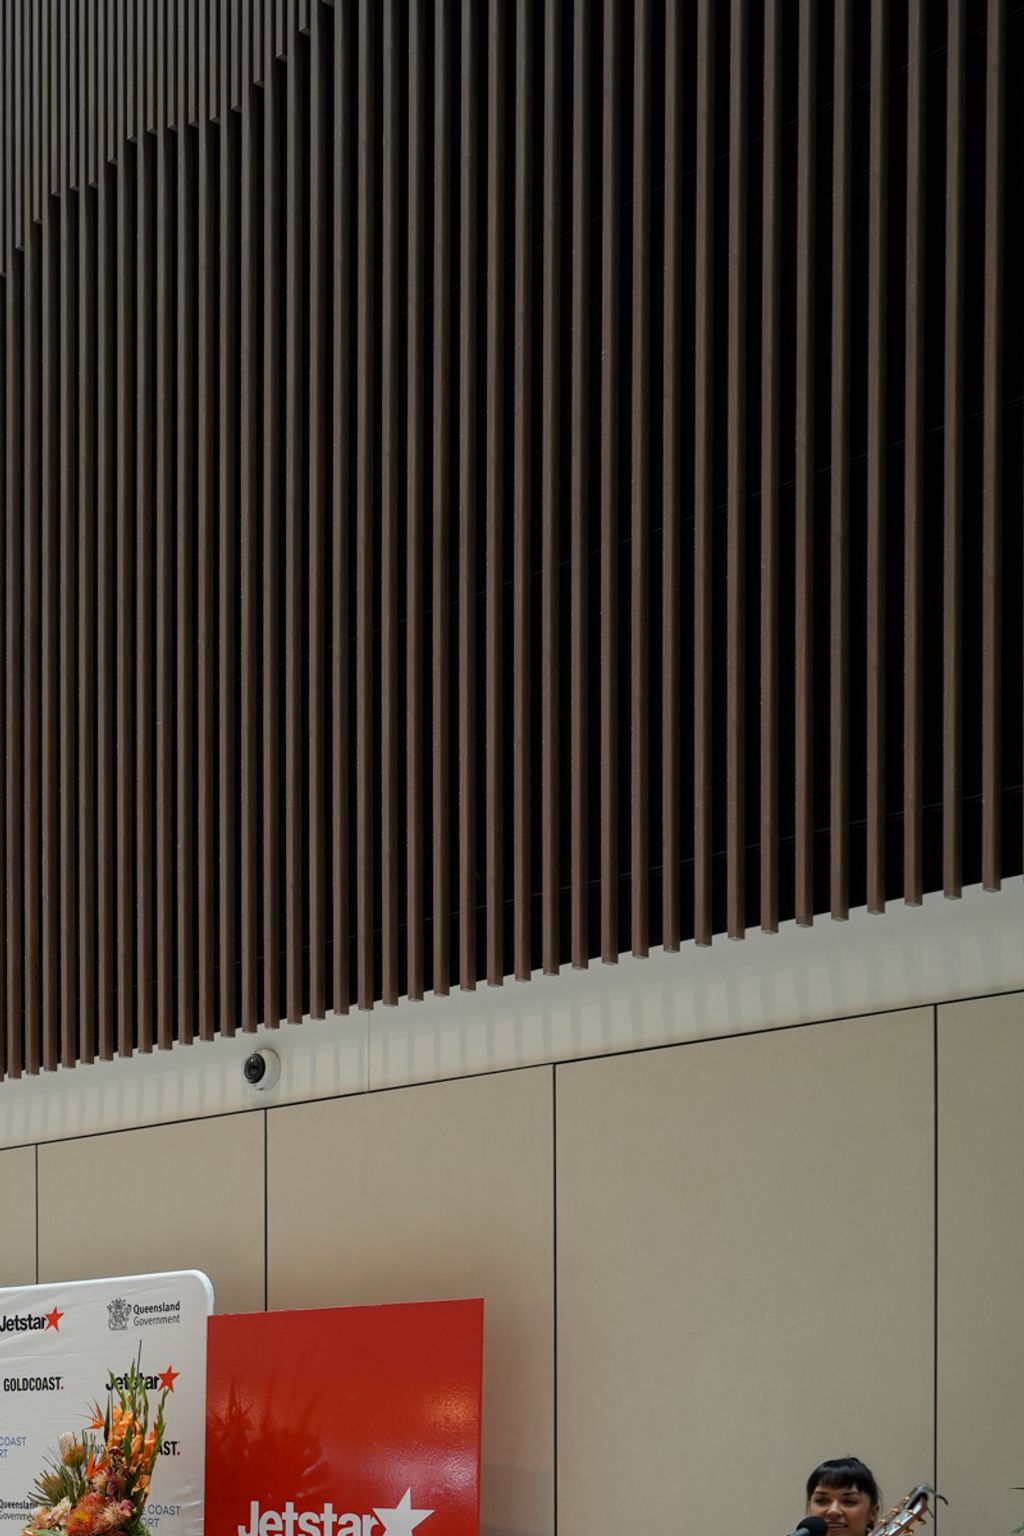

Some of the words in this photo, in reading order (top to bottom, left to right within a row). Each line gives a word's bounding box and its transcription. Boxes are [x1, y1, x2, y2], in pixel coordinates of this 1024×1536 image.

[133, 1301, 180, 1314] Queensland
[133, 1314, 180, 1326] Government
[148, 1504, 181, 1516] COAST
